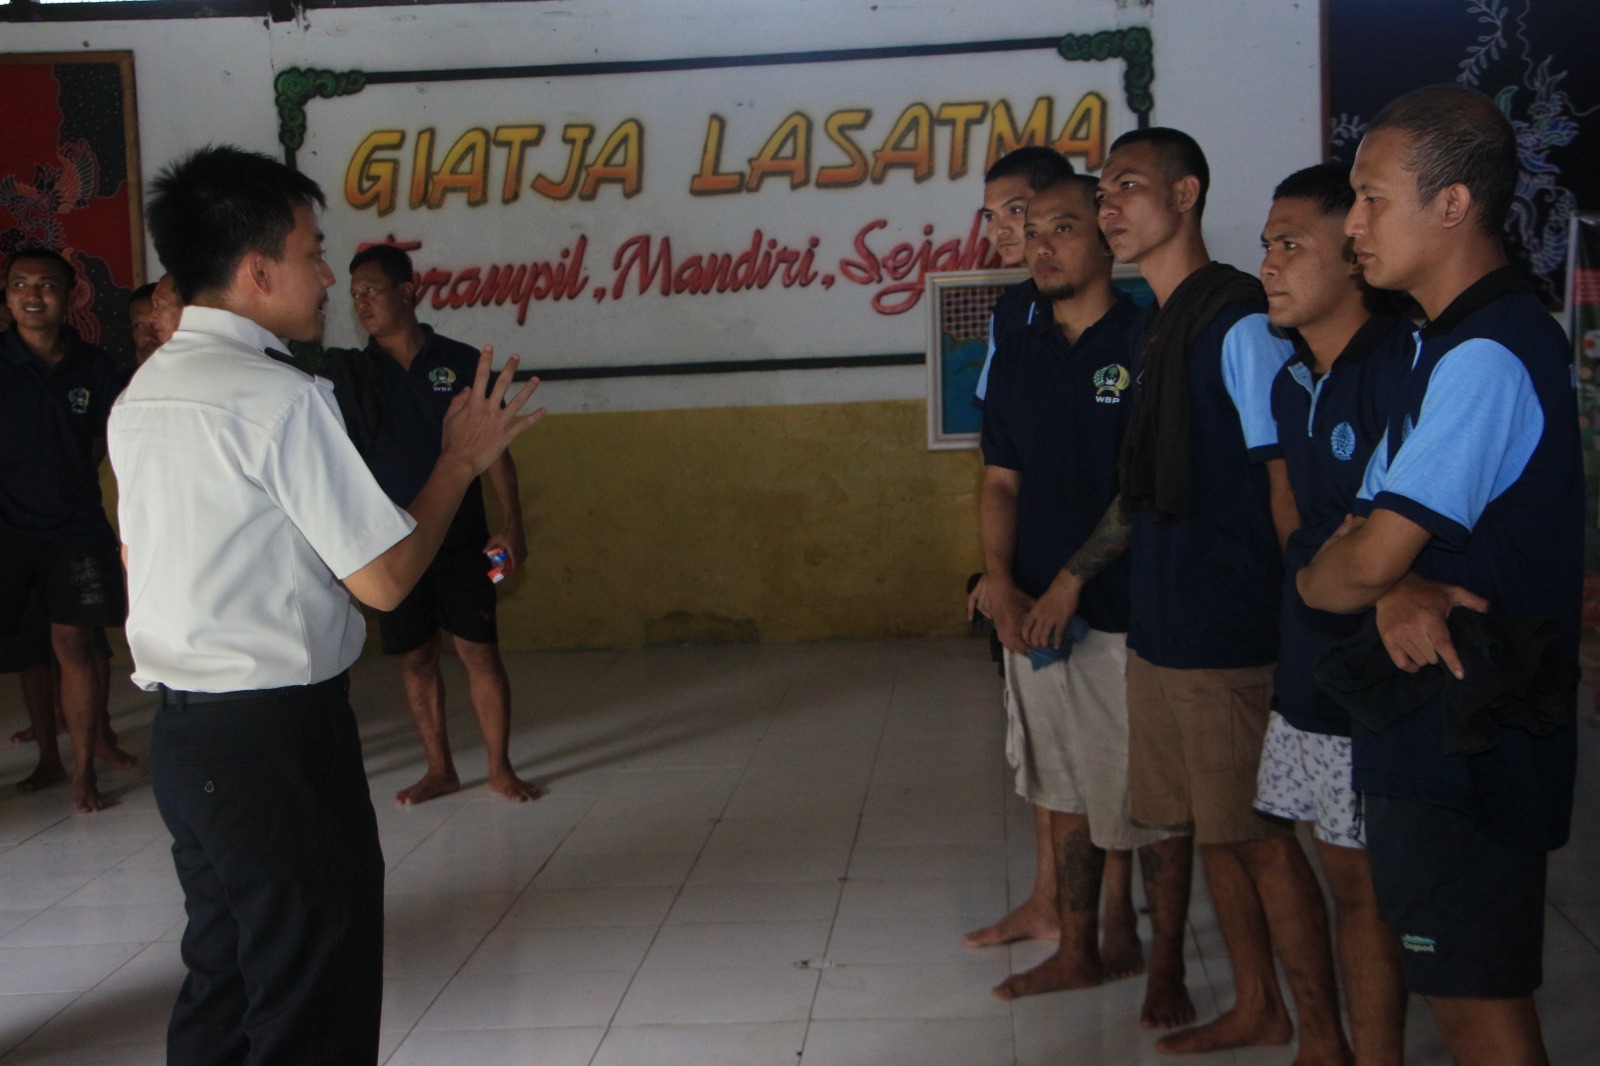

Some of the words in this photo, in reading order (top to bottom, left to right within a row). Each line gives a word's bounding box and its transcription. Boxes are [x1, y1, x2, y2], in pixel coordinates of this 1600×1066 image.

[344, 118, 645, 217] GIATJA
[689, 91, 1107, 197] LASATMA
[1095, 395, 1121, 404] WBP
